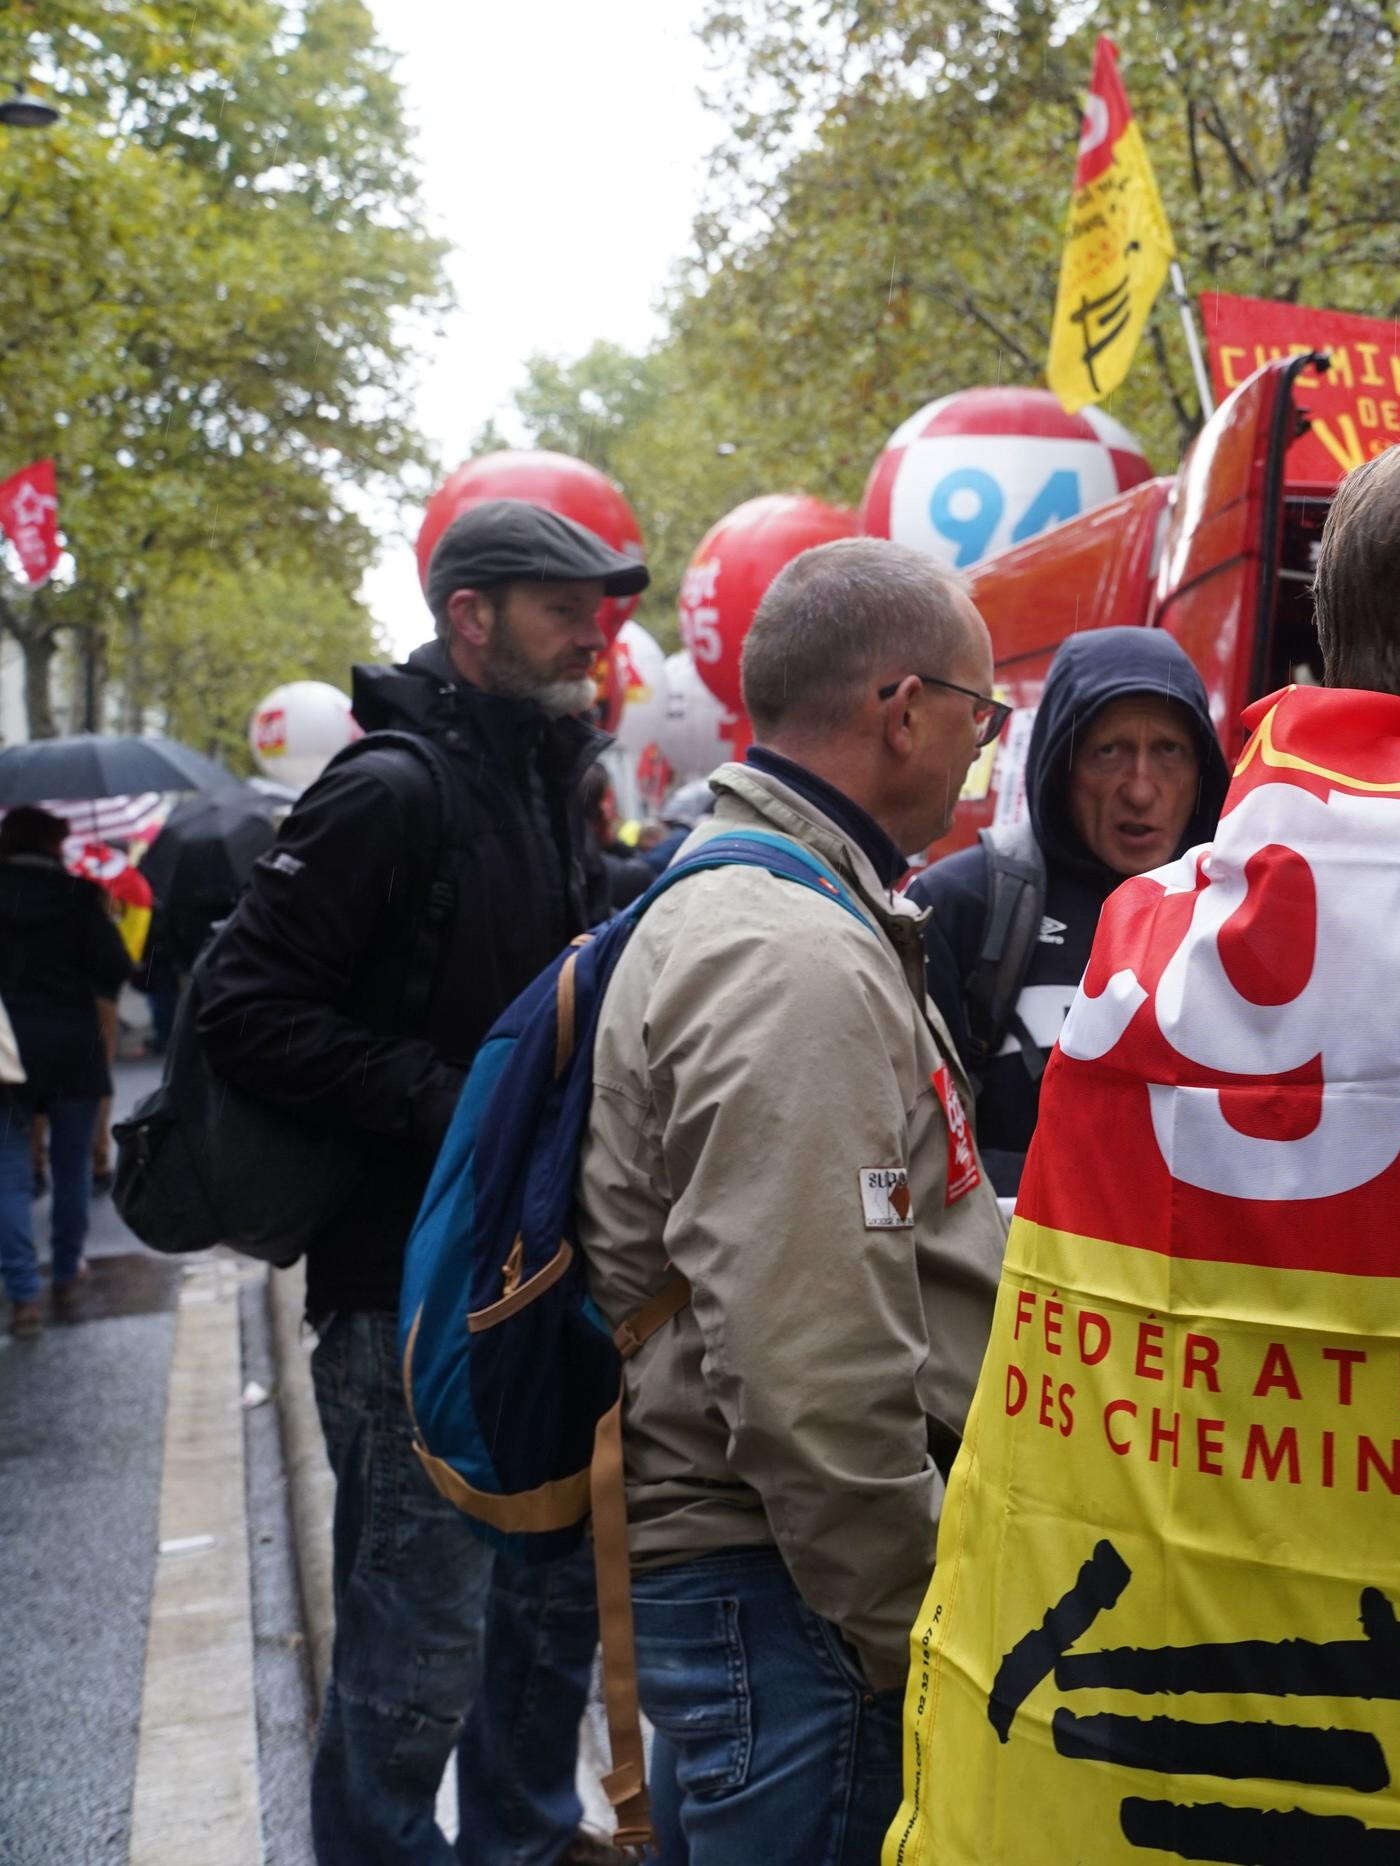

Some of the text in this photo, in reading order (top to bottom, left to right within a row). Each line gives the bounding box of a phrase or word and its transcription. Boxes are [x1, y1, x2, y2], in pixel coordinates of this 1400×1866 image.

[930, 467, 1082, 568] 94
[1005, 1364, 1075, 1438] DES
[917, 1695, 926, 1715] 02
[922, 1671, 930, 1692] 32
[932, 1604, 943, 1623] 70
